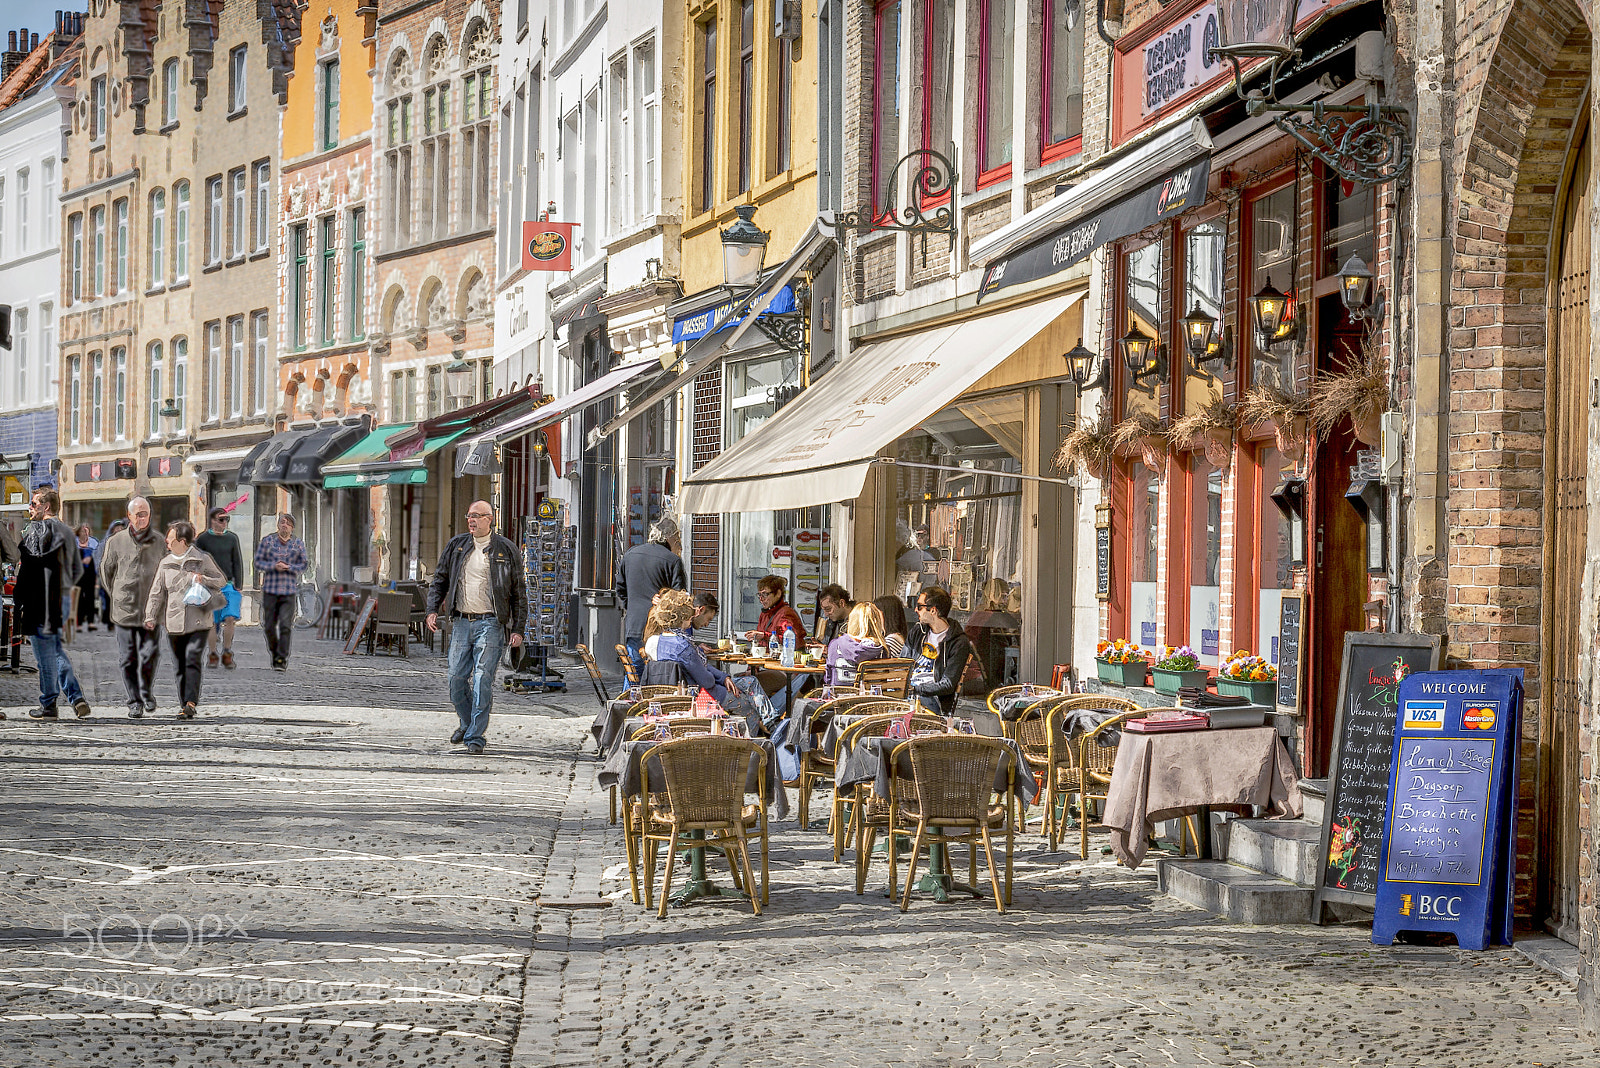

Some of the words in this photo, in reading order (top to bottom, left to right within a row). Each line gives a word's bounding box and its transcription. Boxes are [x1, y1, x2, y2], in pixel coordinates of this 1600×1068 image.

[1421, 682, 1487, 695] WELCOME
[1412, 709, 1438, 721] VISA
[1463, 715, 1495, 723] MasterCard
[1404, 745, 1455, 769] Lunch
[1408, 775, 1464, 800] Dagsoep
[1397, 802, 1478, 822] Brochette
[1419, 894, 1463, 917] BCC
